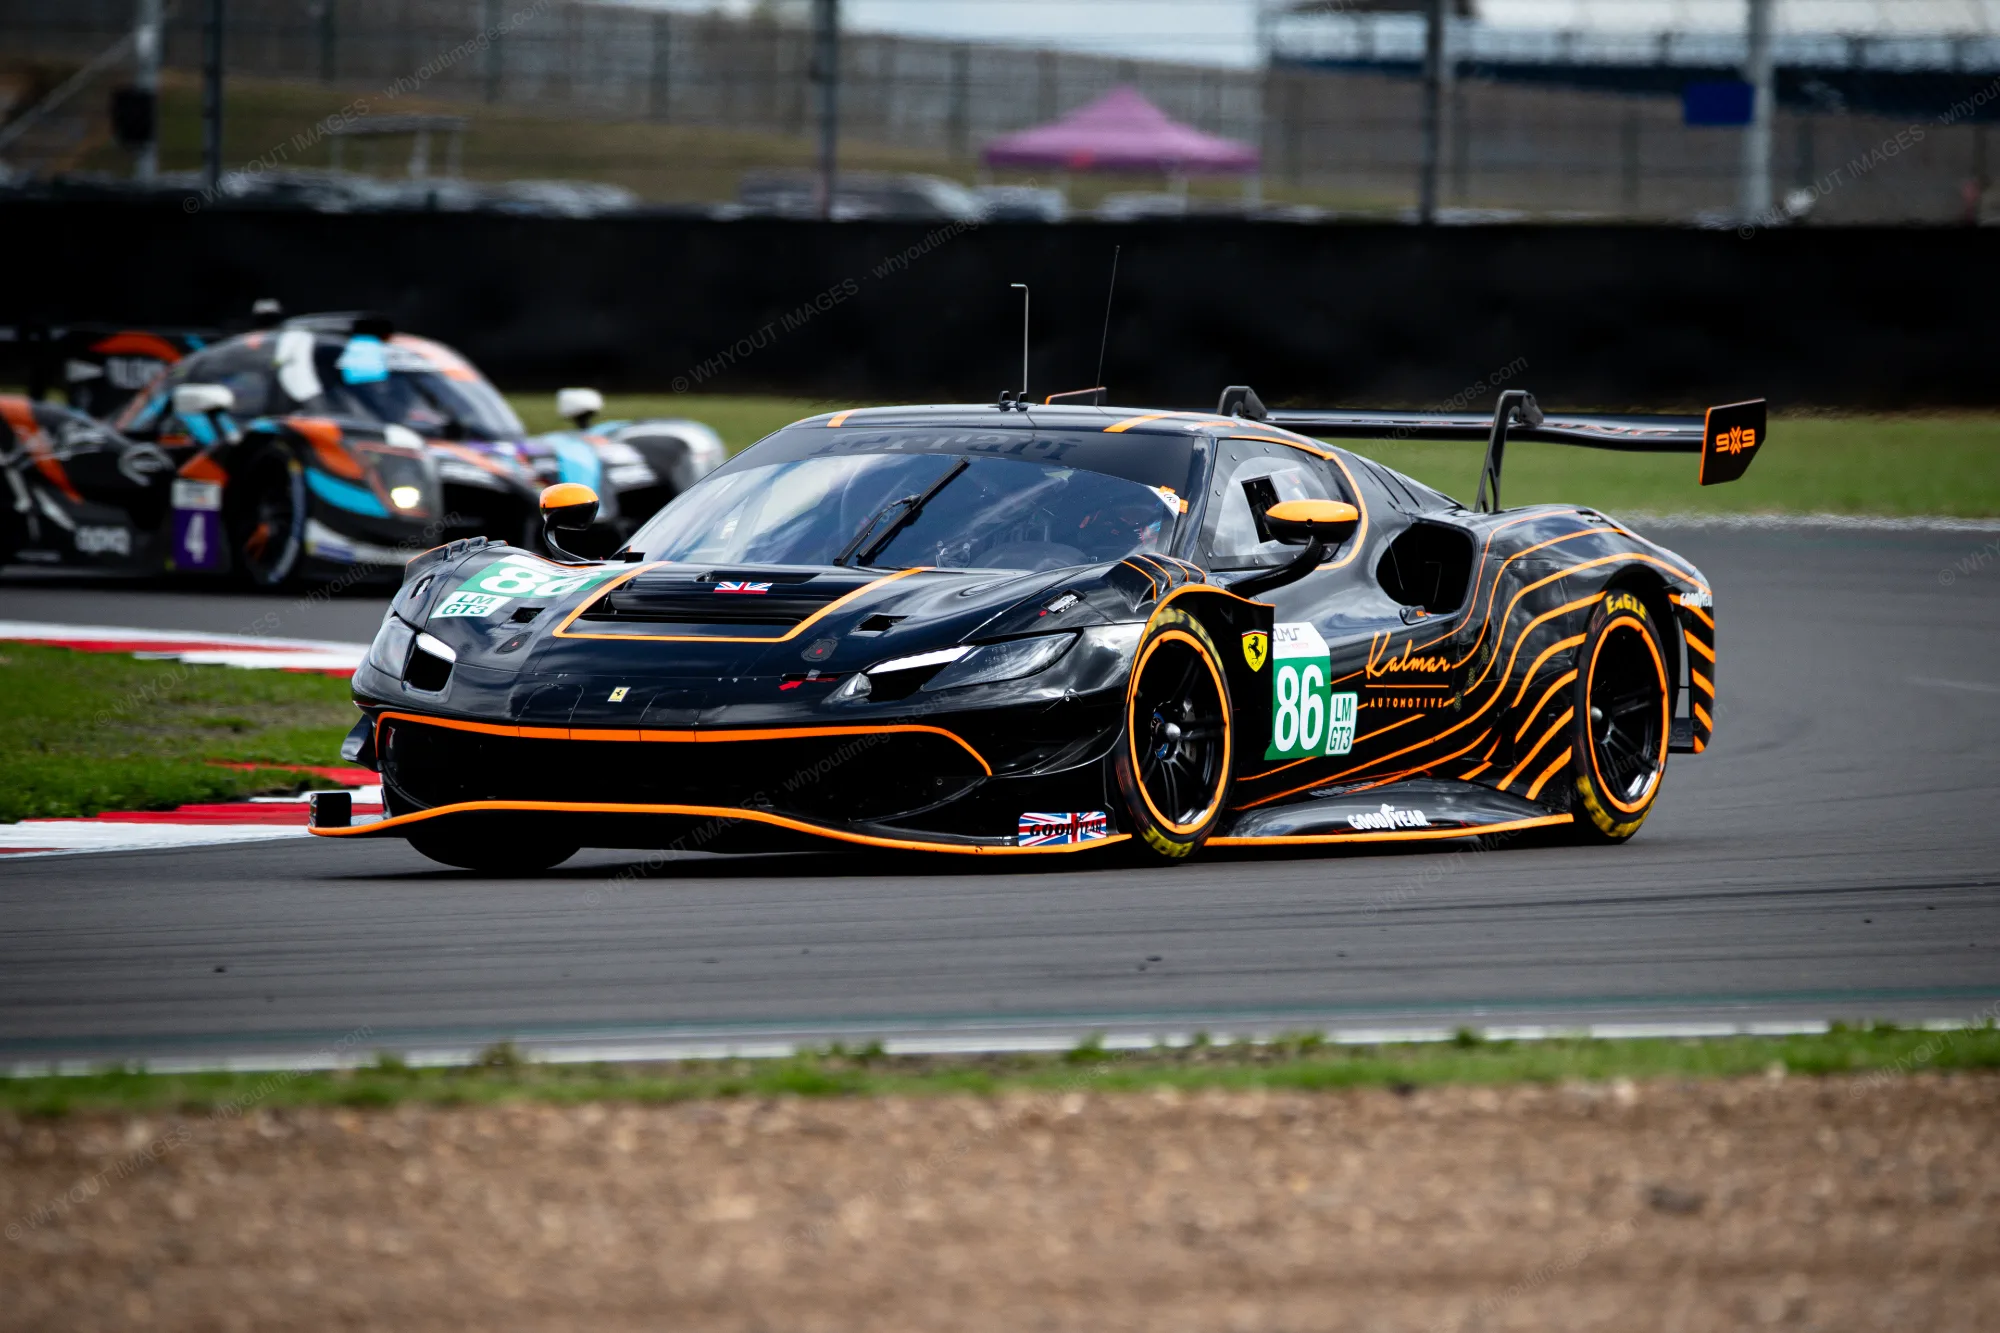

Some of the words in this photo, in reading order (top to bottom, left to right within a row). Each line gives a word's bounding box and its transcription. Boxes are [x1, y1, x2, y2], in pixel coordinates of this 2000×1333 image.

[184, 512, 208, 564] 4
[480, 566, 602, 597] 86
[442, 603, 489, 616] GT3
[457, 594, 496, 605] LM
[1605, 593, 1647, 620] EAGLE
[1365, 631, 1451, 680] Kalmar
[1274, 664, 1325, 752] 86
[1335, 697, 1352, 722] LM
[1370, 697, 1443, 709] AUTOMOTIVE
[1329, 726, 1352, 751] GT3
[1030, 816, 1102, 837] GOODYEAR
[1347, 803, 1432, 830] GOODYEAR
